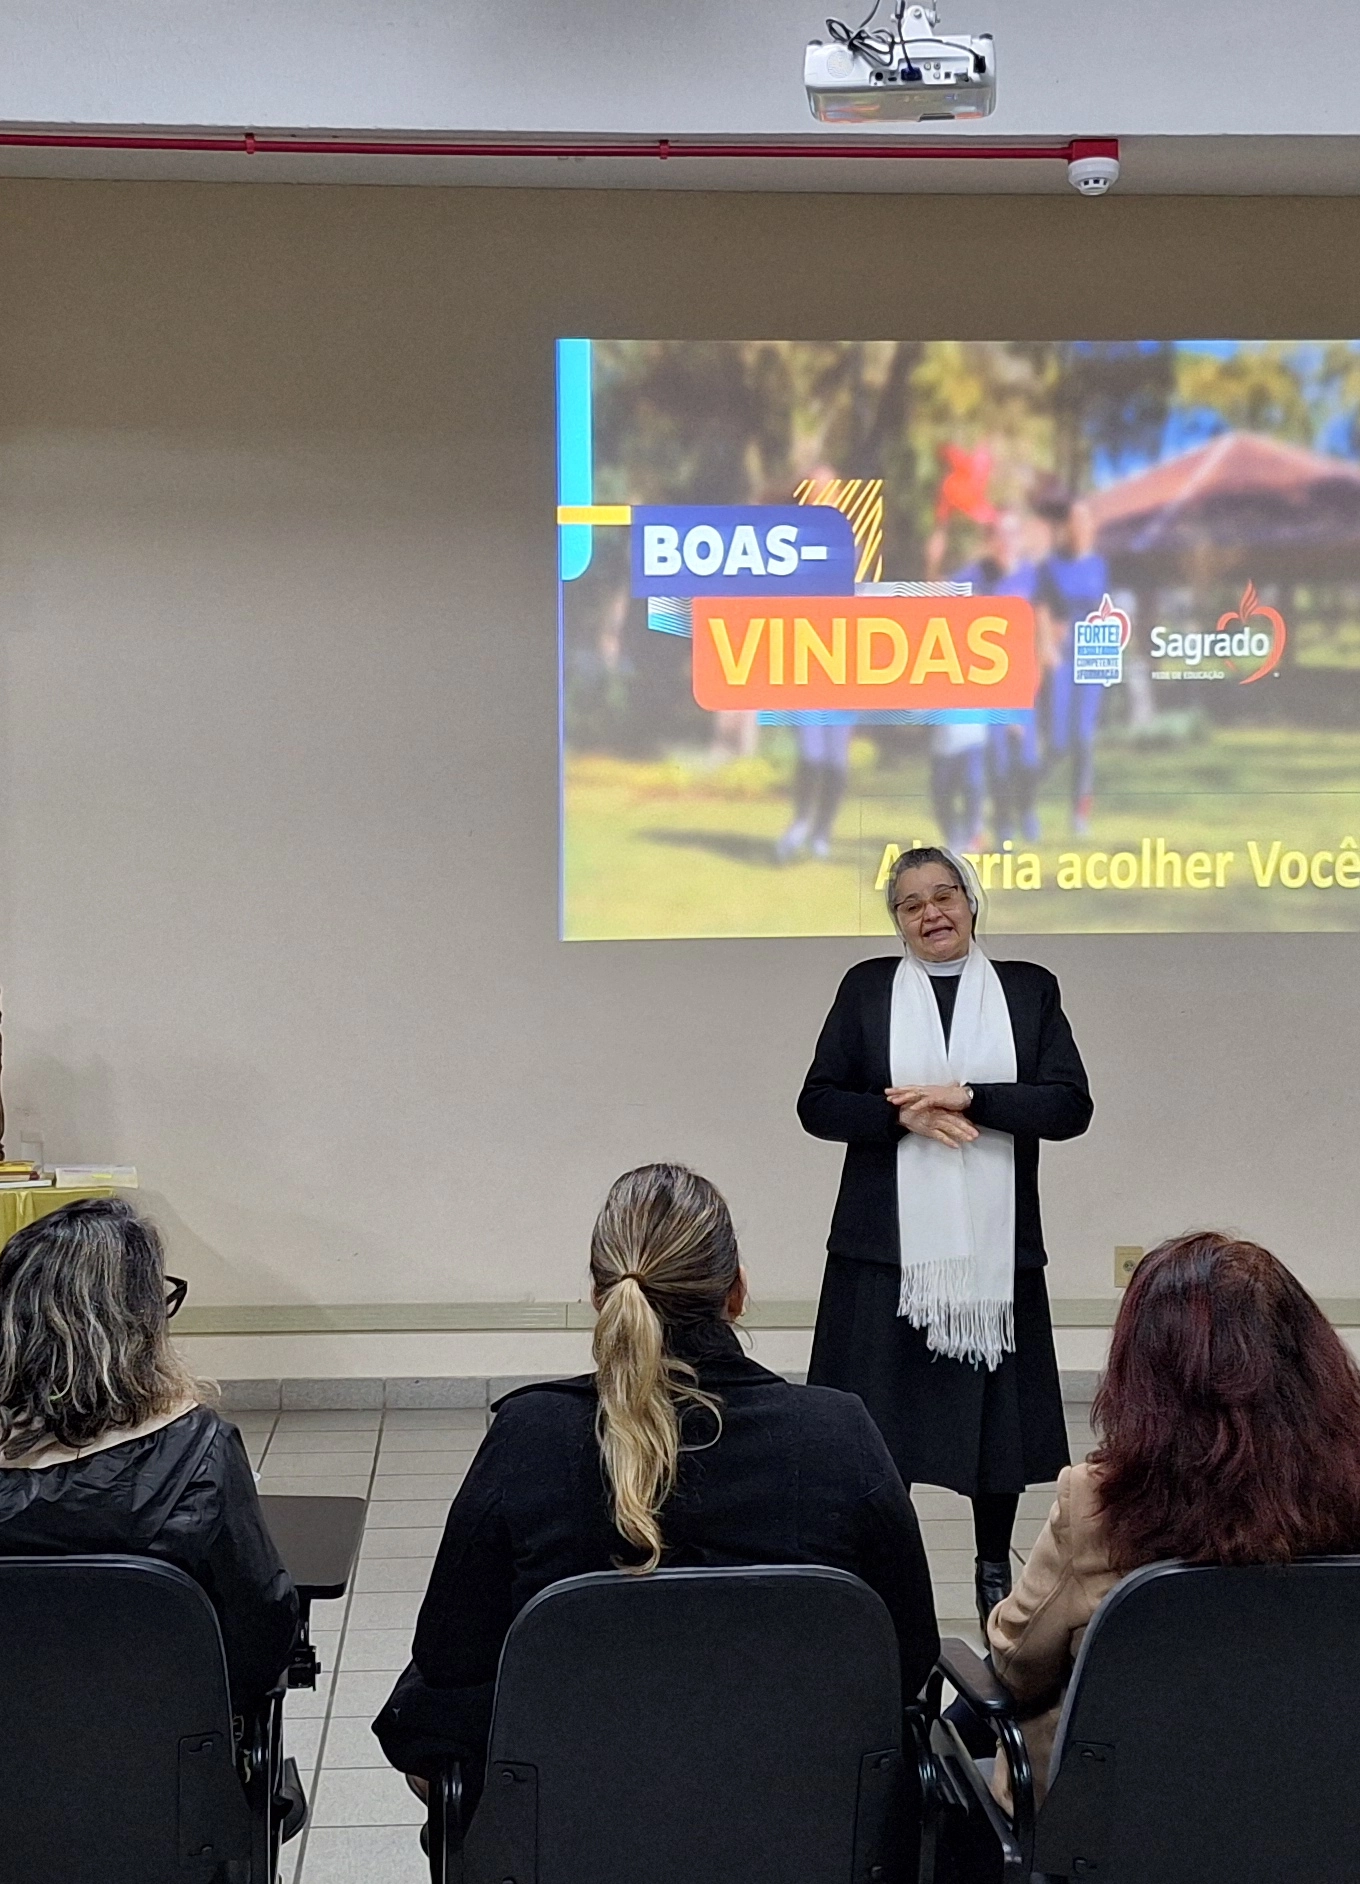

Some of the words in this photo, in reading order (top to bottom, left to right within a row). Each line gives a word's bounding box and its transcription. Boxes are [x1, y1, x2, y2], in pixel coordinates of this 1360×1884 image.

[643, 524, 827, 577] BOAS-
[707, 615, 1009, 686] VINDAS
[1149, 626, 1271, 666] Sagrado
[874, 839, 1041, 891] Aria
[1056, 838, 1234, 890] acolher
